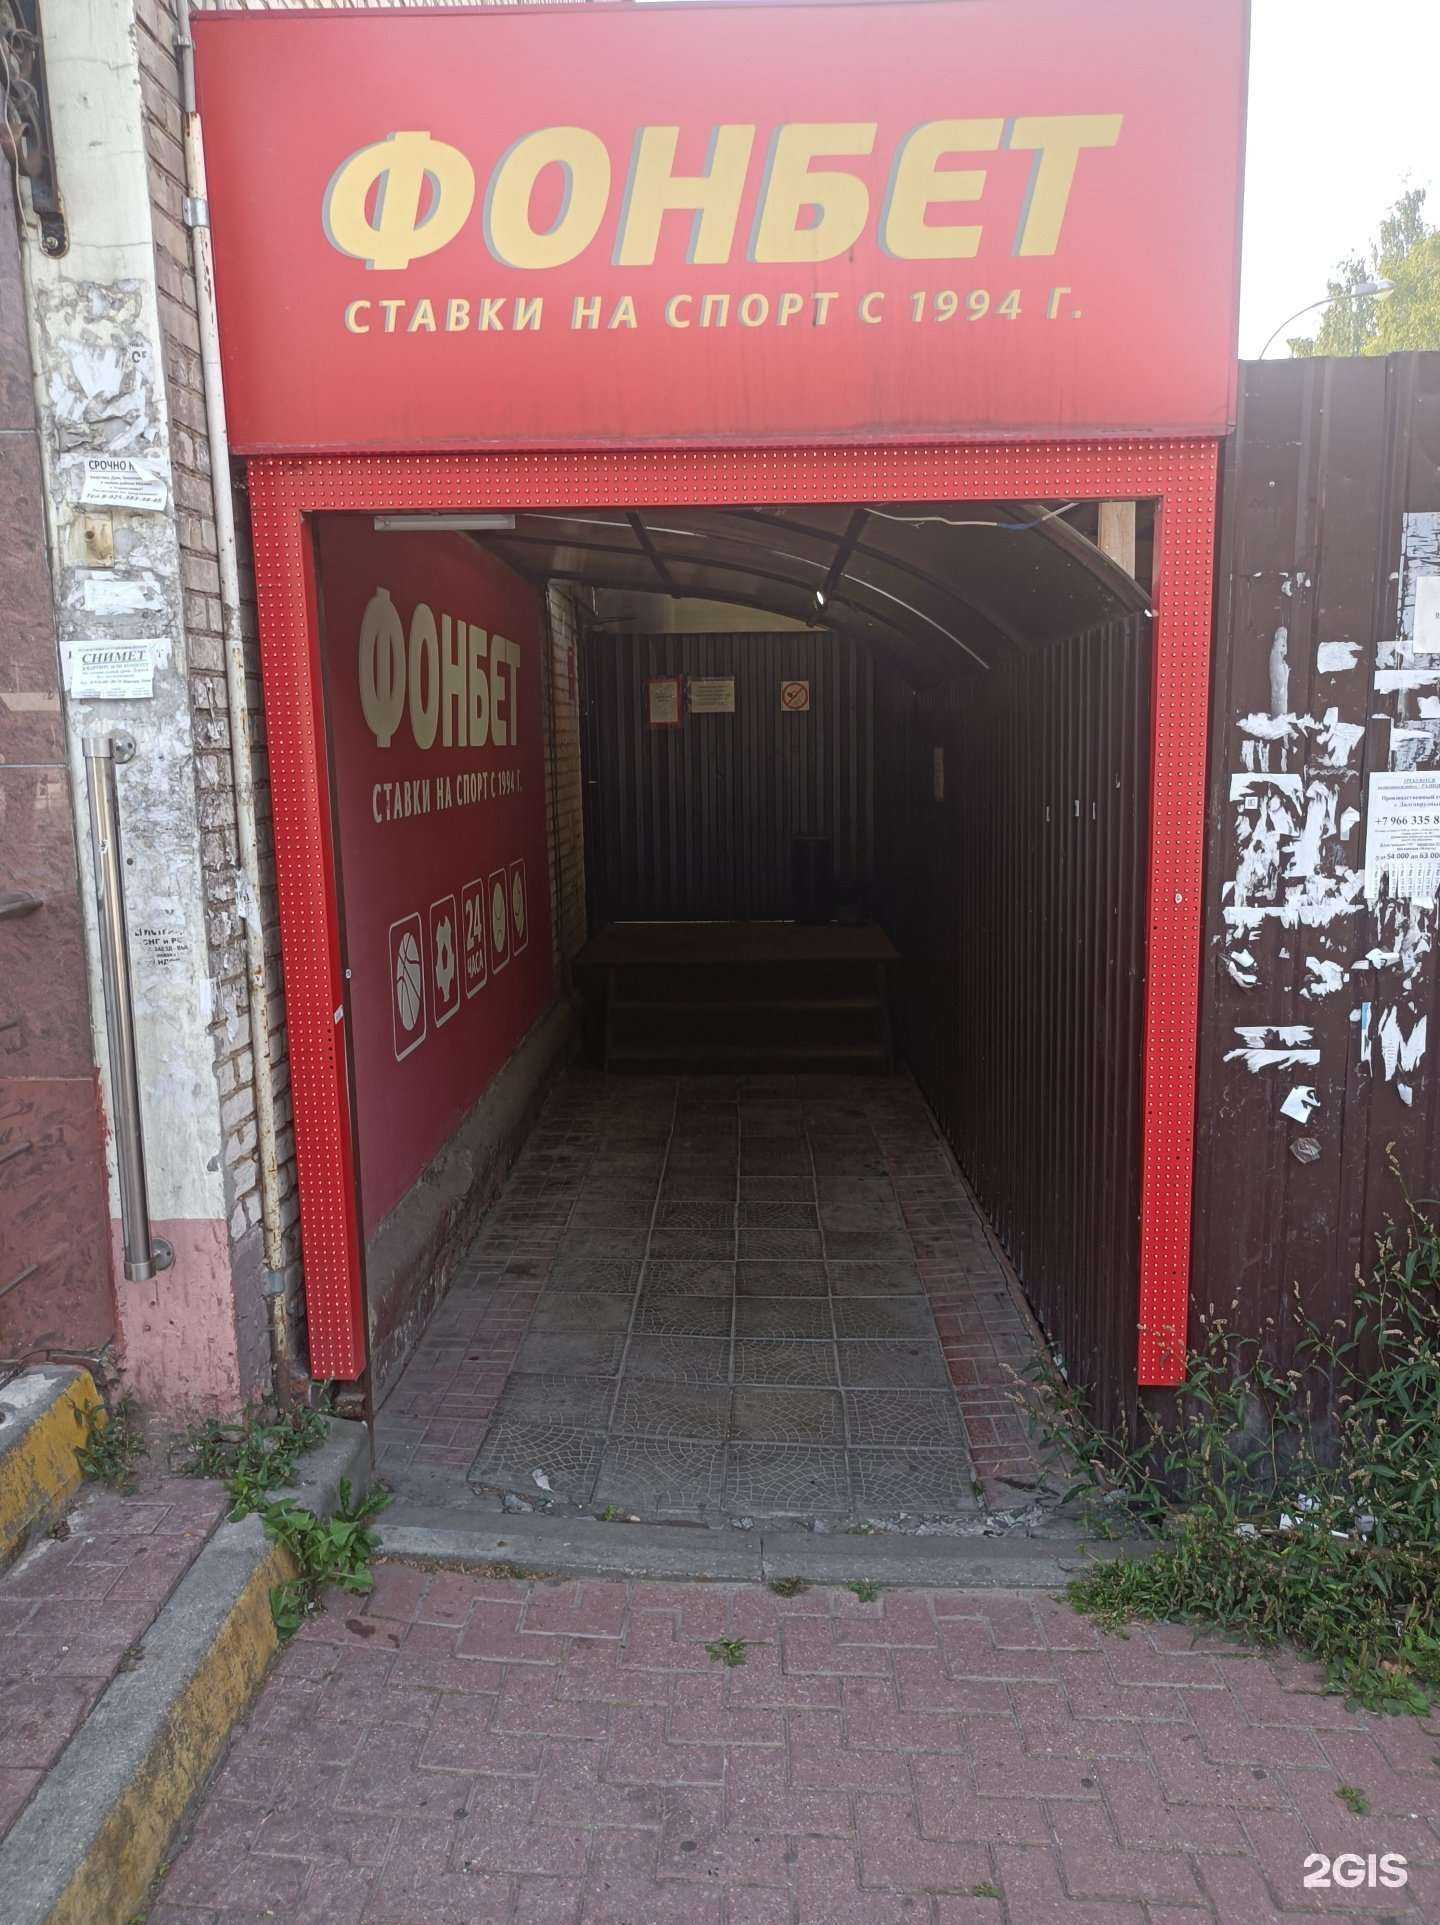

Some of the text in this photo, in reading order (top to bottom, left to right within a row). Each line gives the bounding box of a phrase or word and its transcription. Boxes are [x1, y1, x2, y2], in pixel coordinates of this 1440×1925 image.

[322, 113, 1124, 271] ФОНБЕТ
[344, 286, 1082, 334] СТАВКИ НА СПОРТ С 1994 Г.
[88, 460, 127, 471] СРОЧНО
[82, 651, 146, 664] СНИМЕТ
[358, 586, 521, 751] ФОНБЕТ
[372, 778, 431, 824] СТАВКИ
[436, 776, 453, 810] НА
[456, 771, 489, 806] СПОРТ
[498, 769, 516, 796] 1994
[1375, 816, 1388, 826] +7
[1390, 815, 1408, 825] 966
[1411, 815, 1430, 825] 335
[464, 893, 482, 951] 24
[467, 948, 484, 979] ЧАСА
